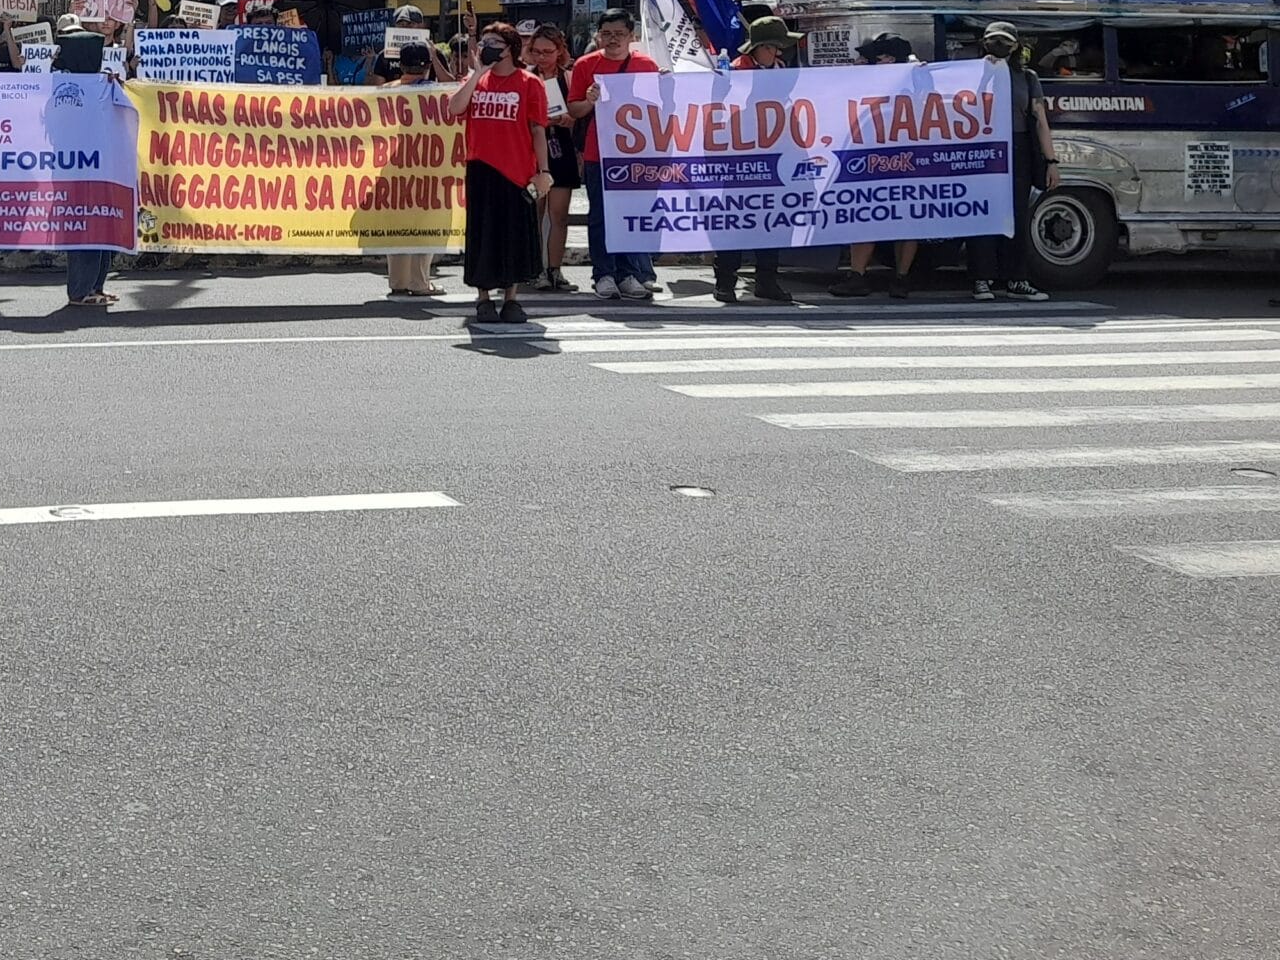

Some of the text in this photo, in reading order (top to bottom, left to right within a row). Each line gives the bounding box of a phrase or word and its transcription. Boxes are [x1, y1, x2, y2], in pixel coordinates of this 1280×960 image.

[137, 30, 200, 41] SAHOD NA
[235, 27, 308, 43] PRESYO NG
[253, 41, 300, 56] LANGIS
[24, 65, 42, 74] ANG
[140, 56, 232, 68] HINDI PONDONG
[257, 71, 273, 82] SA
[157, 90, 227, 126] ITAAS
[234, 93, 283, 129] ANG
[290, 95, 372, 129] SAHOD
[377, 95, 414, 127] NG
[472, 102, 519, 120] PEOPLE
[1058, 96, 1145, 112] GUINOBATAN
[615, 90, 994, 154] SWELDO, ITAAS!
[149, 130, 467, 169] MANGGAGAWANG BUKID A
[916, 158, 930, 166] FOR
[933, 150, 967, 162] SALARY
[968, 149, 996, 160] GRADE
[1, 150, 100, 170] FORUM
[690, 161, 770, 175] ENTRY-LEVEL
[951, 161, 985, 170] EMPLOYEES
[691, 173, 772, 183] SALARY FOR TEACHERS
[137, 171, 298, 211] ANGGAGAWA
[305, 174, 335, 211] SA
[650, 183, 968, 213] ALLIANCE OF CONCERNED
[623, 200, 989, 232] TEACHERS (ACT) BICOL UNION
[3, 220, 60, 232] NGAYON
[64, 220, 87, 231] NA!
[162, 222, 283, 241] SUMABAK-KMB
[292, 229, 325, 238] SAMAHAN
[335, 229, 358, 238] UNYON
[360, 229, 370, 237] NG
[371, 229, 385, 237] MGA
[387, 229, 441, 237] MANGGAGAWANG
